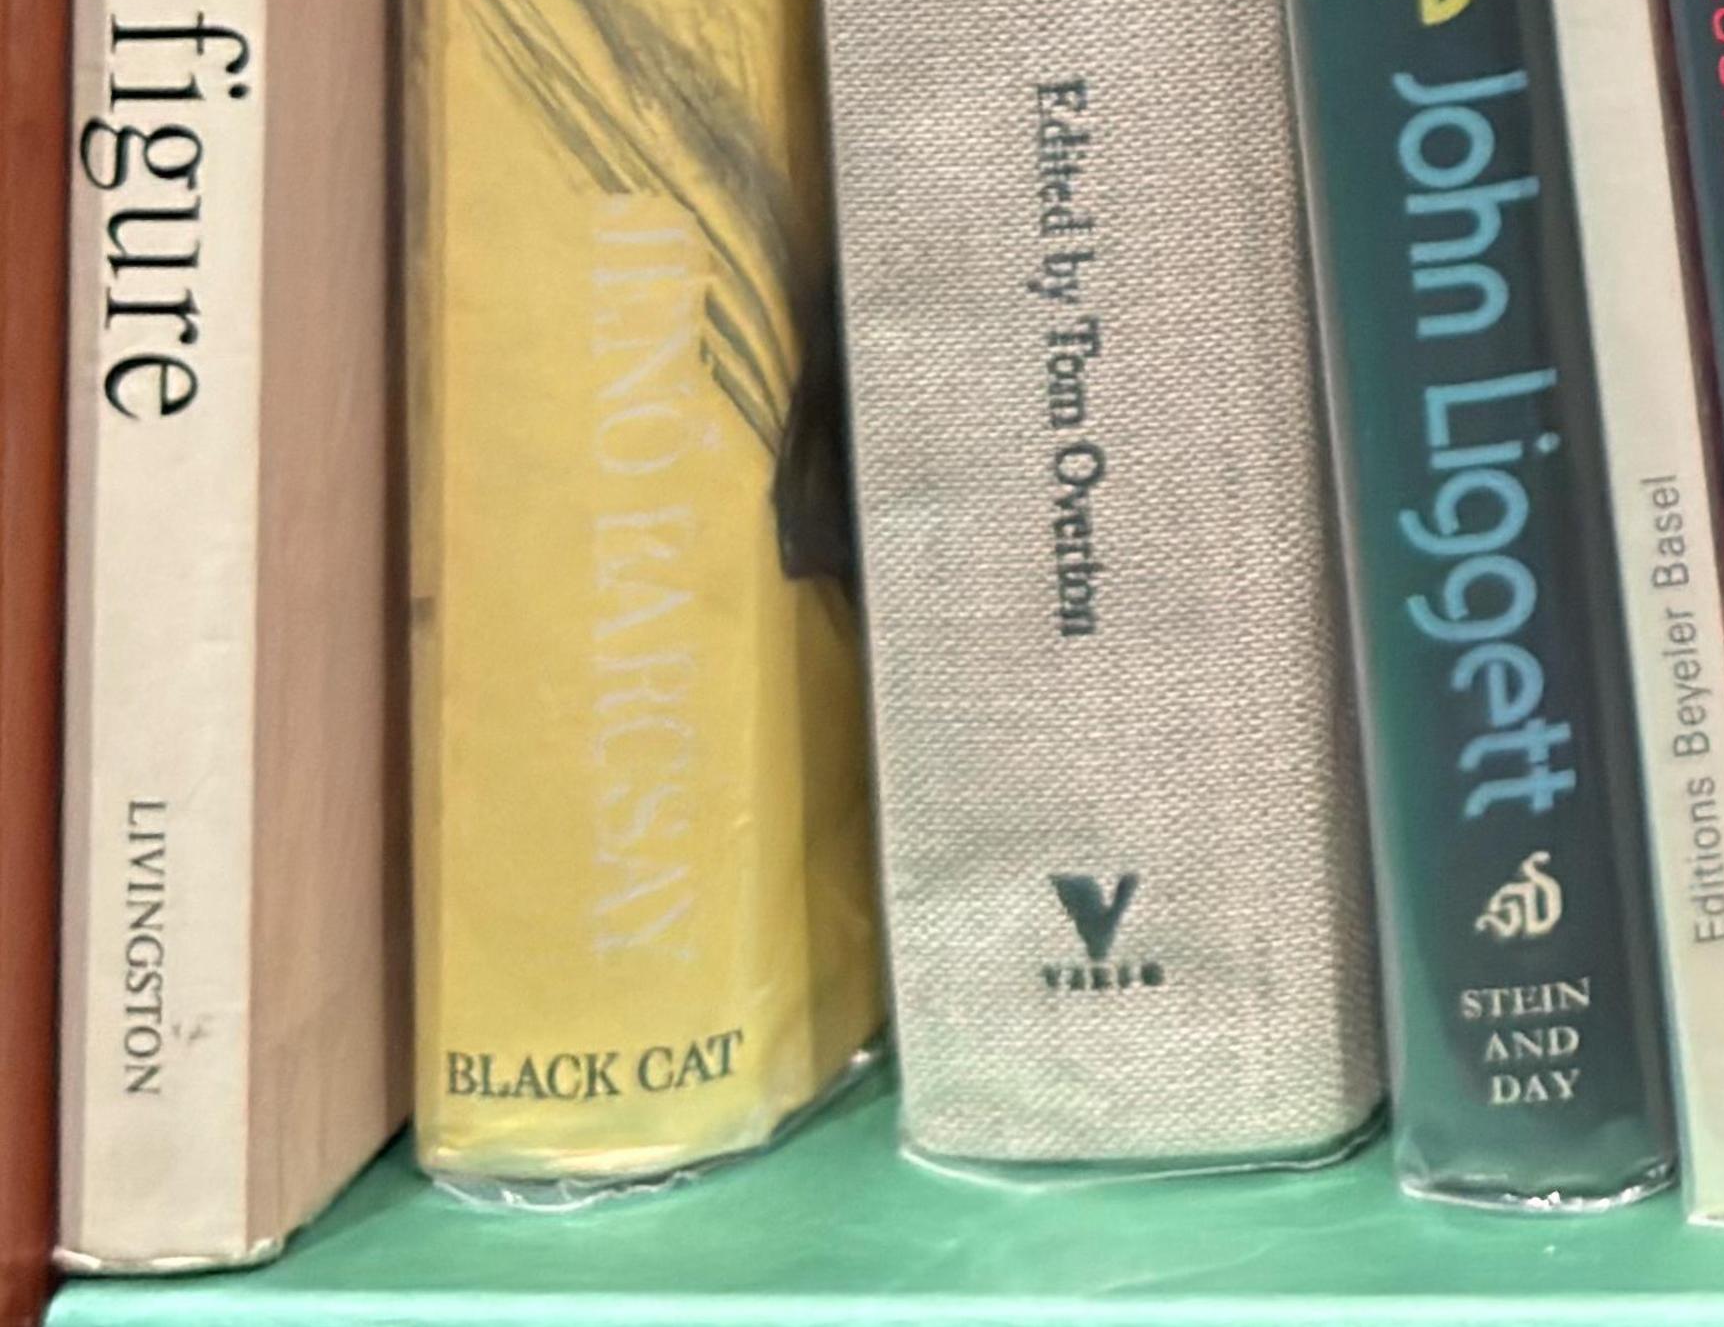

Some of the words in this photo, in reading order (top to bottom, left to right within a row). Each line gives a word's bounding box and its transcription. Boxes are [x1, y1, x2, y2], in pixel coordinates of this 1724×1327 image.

[79, 10, 251, 423] figure
[1033, 78, 1098, 244] Edited
[1393, 66, 1540, 340] John
[1026, 247, 1096, 306] by
[1041, 313, 1102, 430] Tom
[1049, 438, 1107, 637] Overton
[1397, 366, 1578, 820] Liggett
[1641, 472, 1690, 589] Basel
[592, 502, 698, 963] BARCSAY
[1661, 606, 1713, 759] Beyeler
[124, 800, 167, 1096] LIVINGSTON
[1459, 976, 1593, 1022] STEIN
[446, 1050, 619, 1100] BLACK
[637, 1029, 744, 1093] CAT
[1483, 1023, 1581, 1062] AND
[1489, 1067, 1581, 1106] DAY
